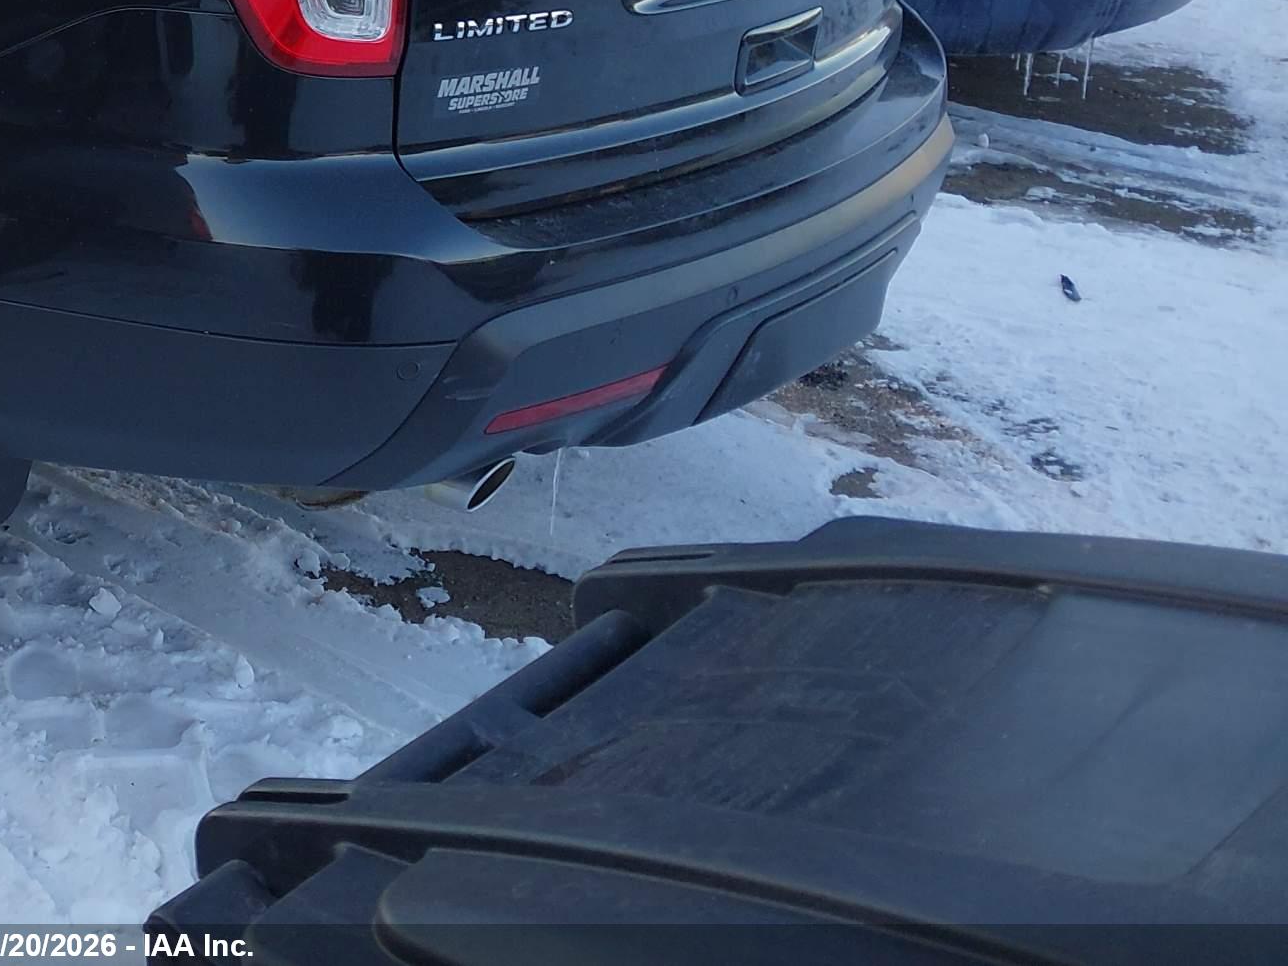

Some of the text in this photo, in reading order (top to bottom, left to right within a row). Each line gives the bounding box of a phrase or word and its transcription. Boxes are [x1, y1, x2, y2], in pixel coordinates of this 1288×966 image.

[434, 10, 573, 41] LIMITED
[437, 66, 541, 98] MARSHALL
[448, 87, 529, 111] SUPERSTORE
